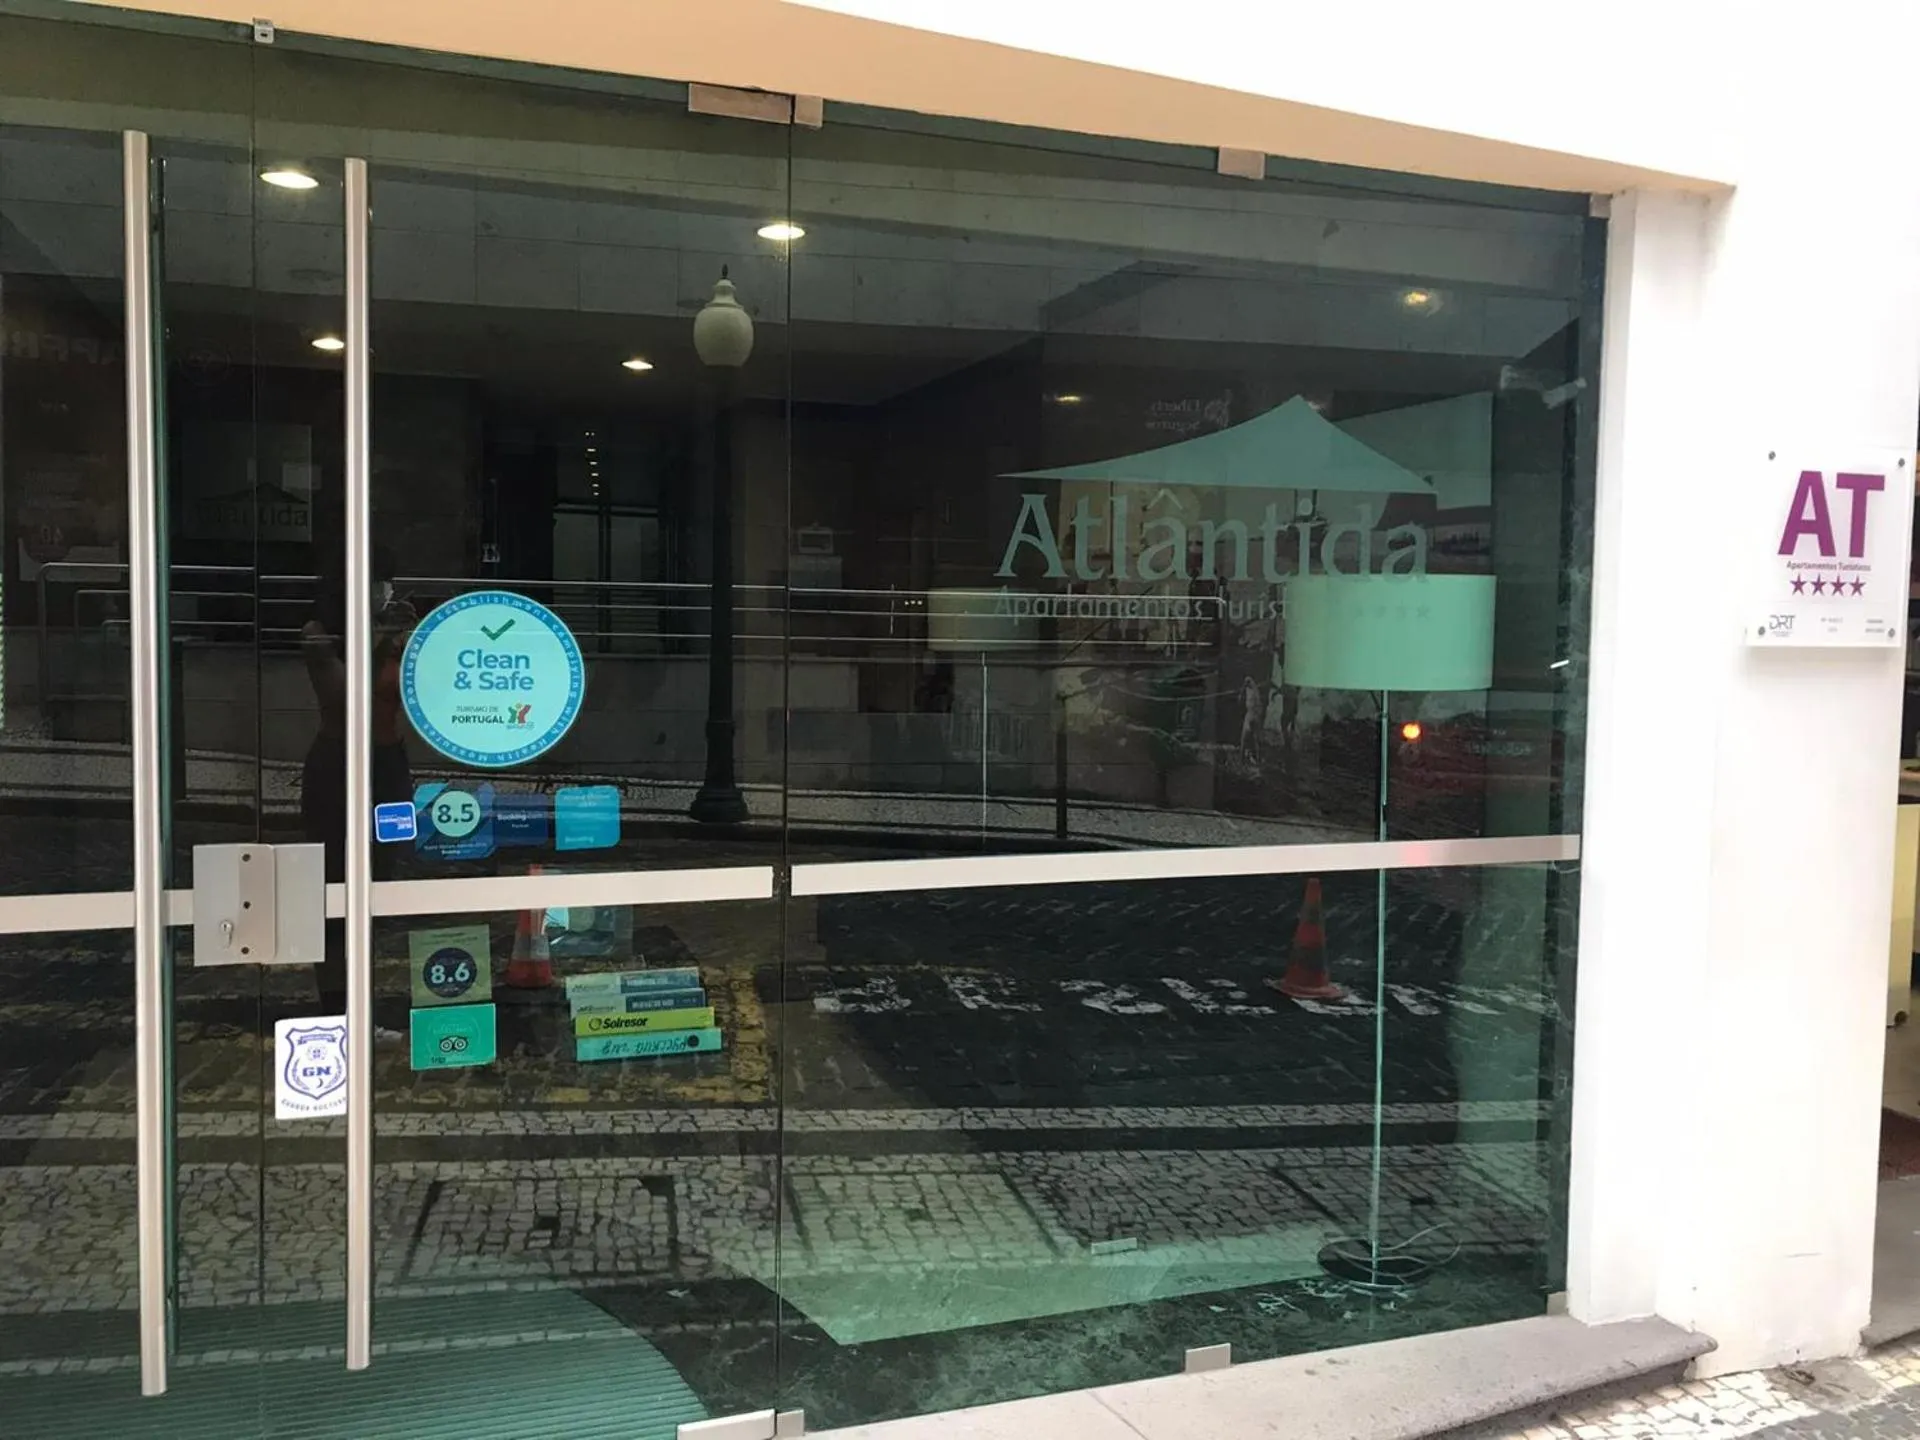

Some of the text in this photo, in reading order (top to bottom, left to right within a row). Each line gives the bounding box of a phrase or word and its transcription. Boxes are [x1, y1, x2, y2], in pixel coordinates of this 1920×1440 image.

[1778, 470, 1885, 558] AT
[994, 487, 1432, 582] Atlântida
[994, 583, 1203, 624] Apartamentos
[1768, 614, 1796, 630] DRT
[457, 649, 530, 670] Clean
[453, 671, 535, 691] & Safe
[451, 715, 505, 724] PORTUGAL
[437, 803, 474, 824] 8.5
[430, 962, 470, 984] 8.6
[602, 1015, 648, 1029] Solresor
[302, 1066, 332, 1077] GN
